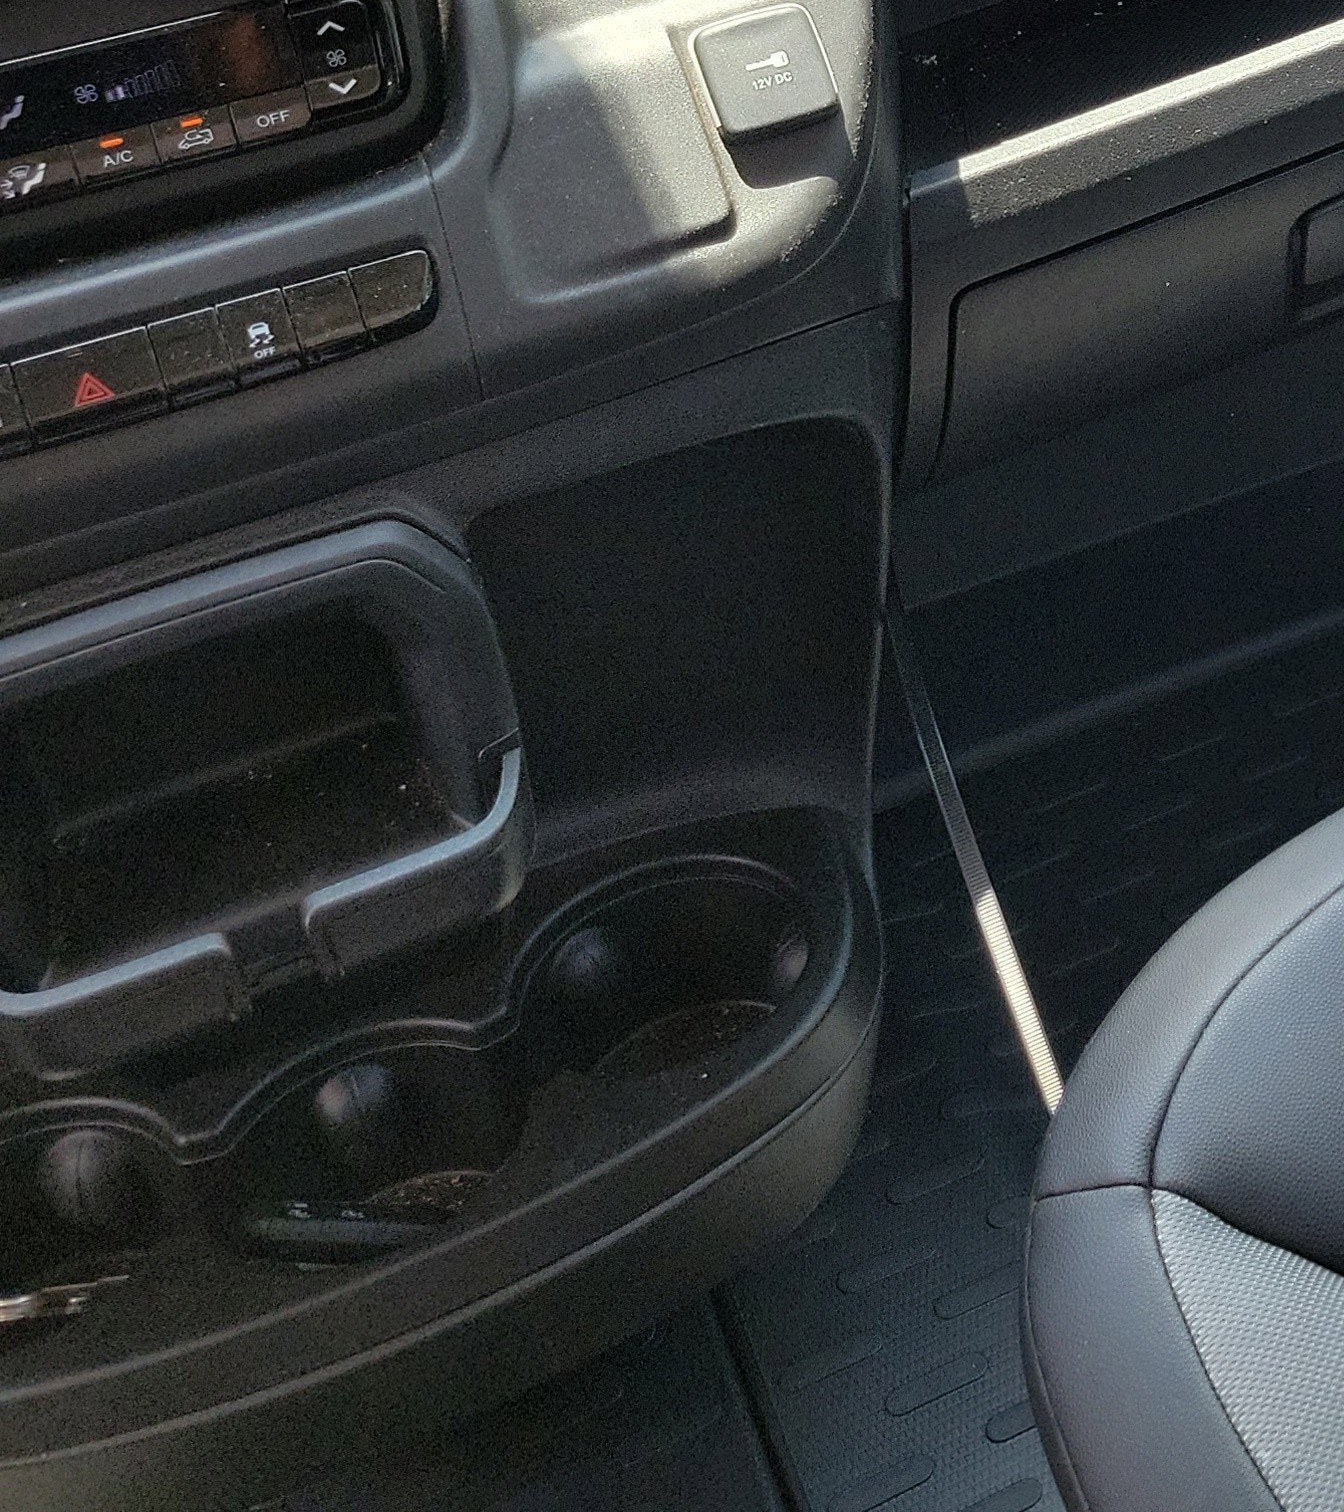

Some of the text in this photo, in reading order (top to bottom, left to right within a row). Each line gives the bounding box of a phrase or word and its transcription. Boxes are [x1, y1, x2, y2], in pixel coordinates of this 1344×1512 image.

[752, 70, 794, 91] 12V DC
[256, 109, 290, 128] OFF
[103, 149, 134, 168] A/C
[254, 345, 276, 359] OFF
